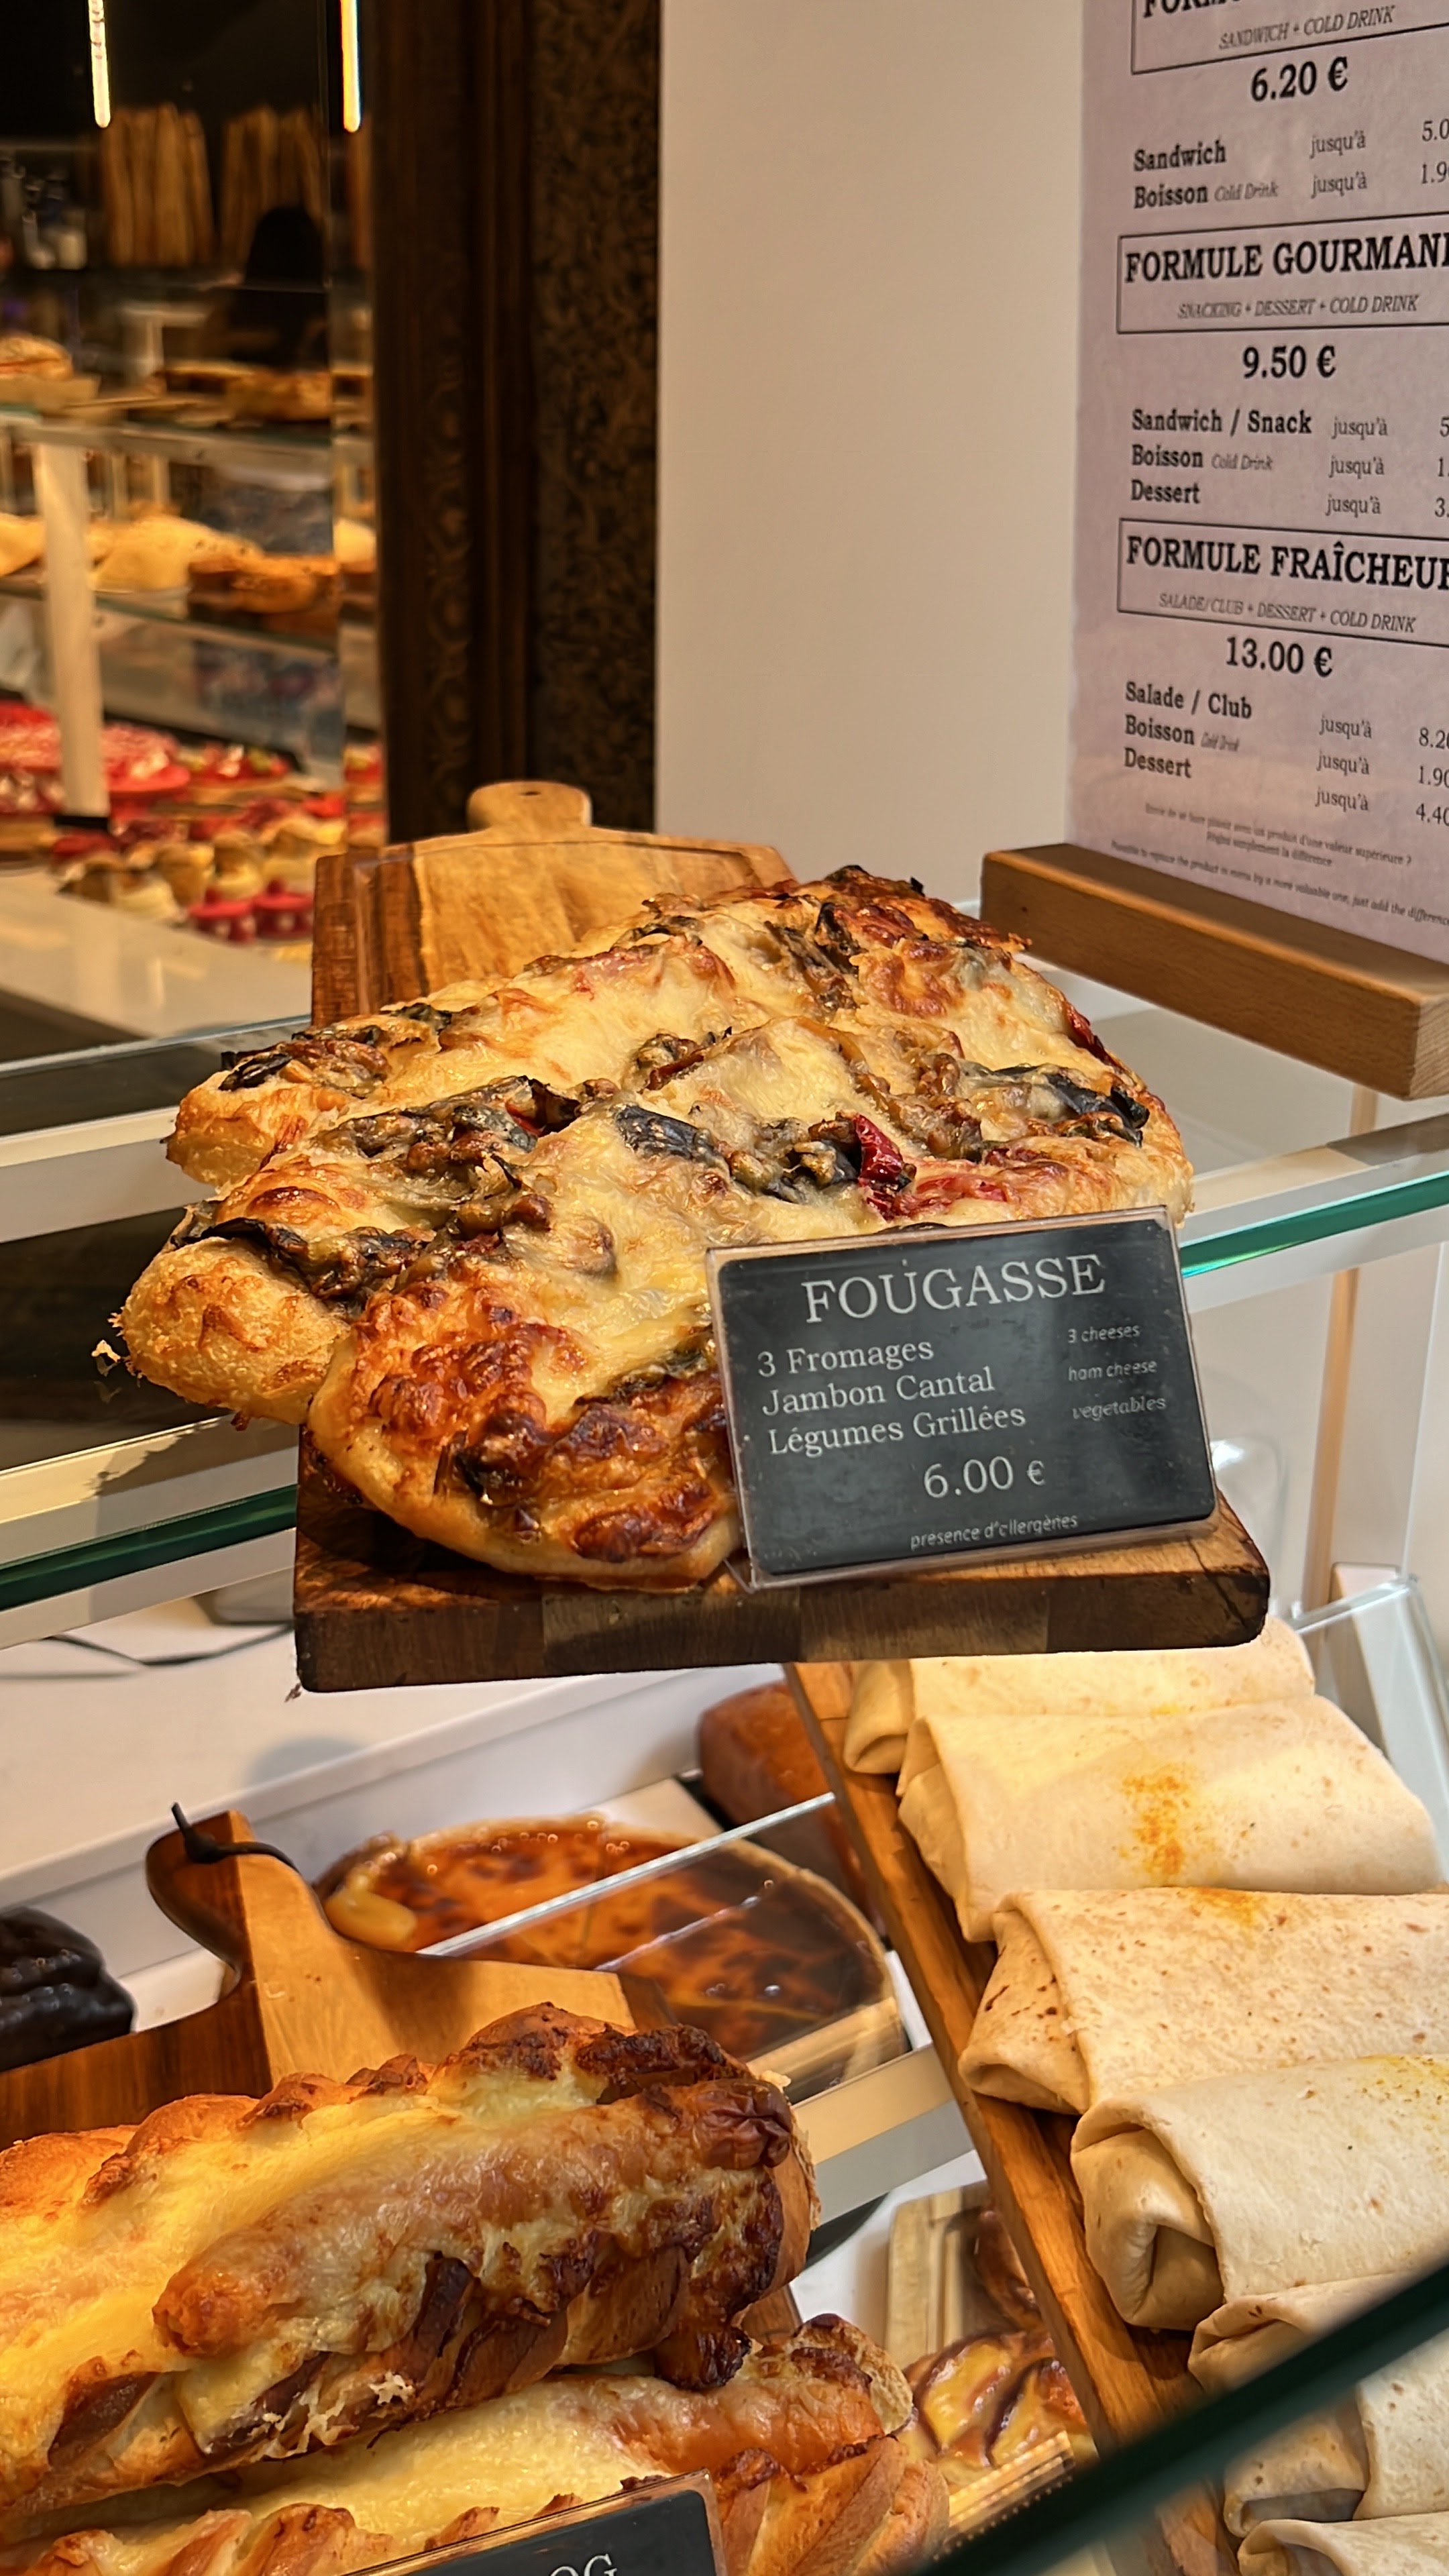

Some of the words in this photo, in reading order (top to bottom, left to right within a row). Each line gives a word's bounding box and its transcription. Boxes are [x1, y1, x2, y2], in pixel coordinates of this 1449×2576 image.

[1219, 23, 1289, 50] SANDWICH
[1303, 13, 1344, 36] COLD
[1347, 5, 1395, 30] DRINK
[1251, 61, 1317, 102] 6.20
[1328, 56, 1348, 91] €
[1134, 139, 1226, 172] Sandwich
[1310, 130, 1366, 158] jusqu'à
[1134, 182, 1208, 209] Boisson
[1311, 172, 1367, 199] jusqu'à
[1421, 161, 1449, 184] 1.9
[1125, 244, 1263, 283] FORMULE
[1254, 299, 1316, 317] DESSERT
[1330, 297, 1368, 314] COLD
[1372, 294, 1419, 313] DRINK
[1242, 345, 1307, 379] 9.50
[1317, 345, 1336, 378] €
[1132, 408, 1222, 432] Sandwich
[1230, 408, 1240, 437] /
[1248, 409, 1312, 434] Snack
[1331, 417, 1388, 441] jusqu'à
[1132, 444, 1203, 468] Boisson
[1328, 456, 1385, 480] jusqu'à
[1131, 479, 1200, 504] Dessert
[1326, 494, 1381, 519] jusqu'à
[1126, 535, 1260, 574] FORMULE
[1257, 602, 1316, 623] DESSERT
[1330, 610, 1367, 628] COLD
[1371, 613, 1417, 633] DRINK
[1226, 637, 1304, 674] 13.00
[1313, 647, 1333, 678] €
[1126, 680, 1184, 709] Salade
[1191, 689, 1200, 715] /
[1208, 692, 1252, 719] Club
[1319, 714, 1372, 740] jusqu'à
[1125, 714, 1195, 745] Boisson
[1316, 749, 1369, 776] jusqu'à
[1124, 747, 1191, 779] Dessert
[1315, 786, 1368, 812] jusqu'à
[801, 1254, 1106, 1324] FOUGASSE
[1067, 1328, 1077, 1344] 3
[1081, 1325, 1140, 1342] cheeses
[757, 1351, 775, 1377] 3
[786, 1341, 934, 1374] Fromages
[1068, 1366, 1103, 1381] ham
[1106, 1360, 1158, 1377] cheese
[762, 1383, 886, 1417] Jambon
[896, 1366, 996, 1401] Cantal
[1072, 1395, 1167, 1421] vegetables
[768, 1421, 904, 1458] Légumes
[913, 1405, 1026, 1438] Grillées
[924, 1455, 1014, 1499] 6.00
[1026, 1459, 1045, 1486] €
